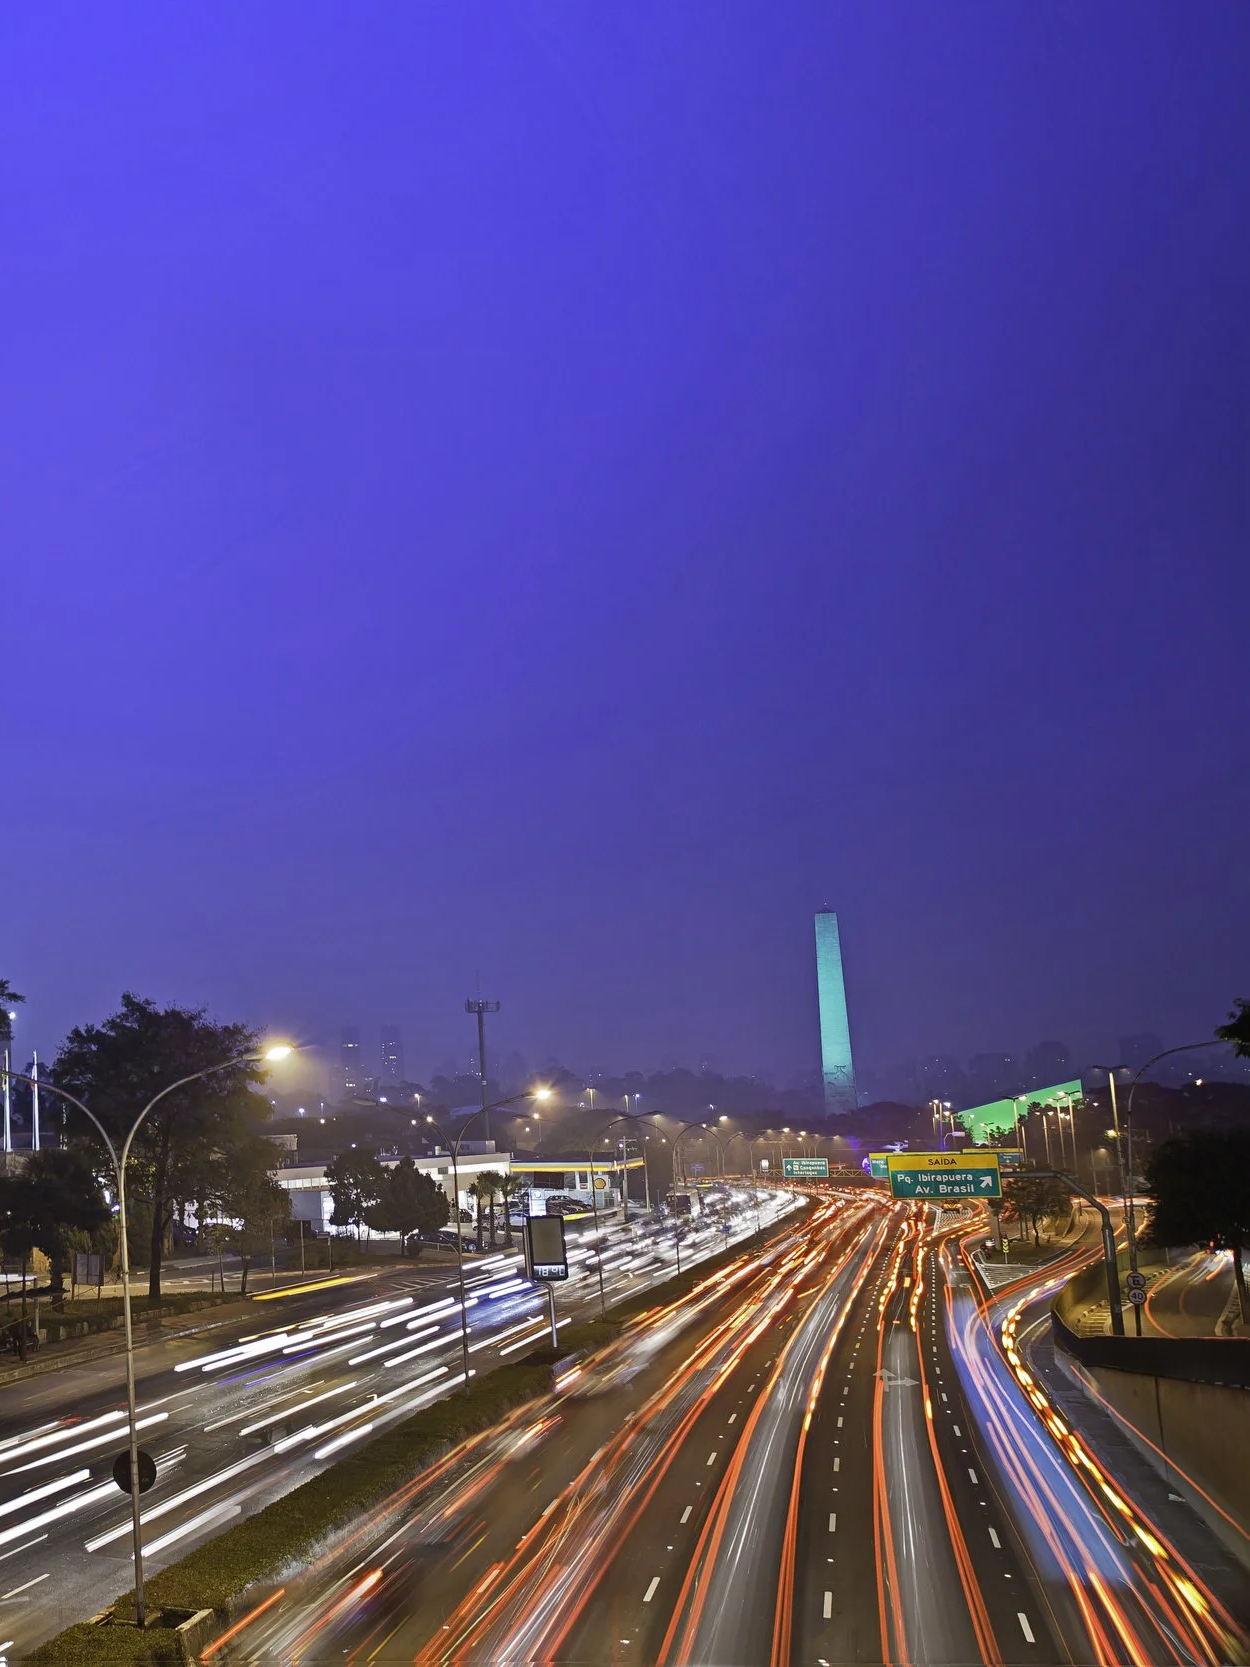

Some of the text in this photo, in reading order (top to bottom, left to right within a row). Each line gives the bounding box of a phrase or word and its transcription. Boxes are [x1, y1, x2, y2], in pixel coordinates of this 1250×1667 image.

[928, 1158, 957, 1166] SAÍDA
[897, 1173, 973, 1184] Pq. Ibirapuera
[915, 1184, 974, 1194] Av. Brasil
[1131, 1292, 1144, 1300] 40
